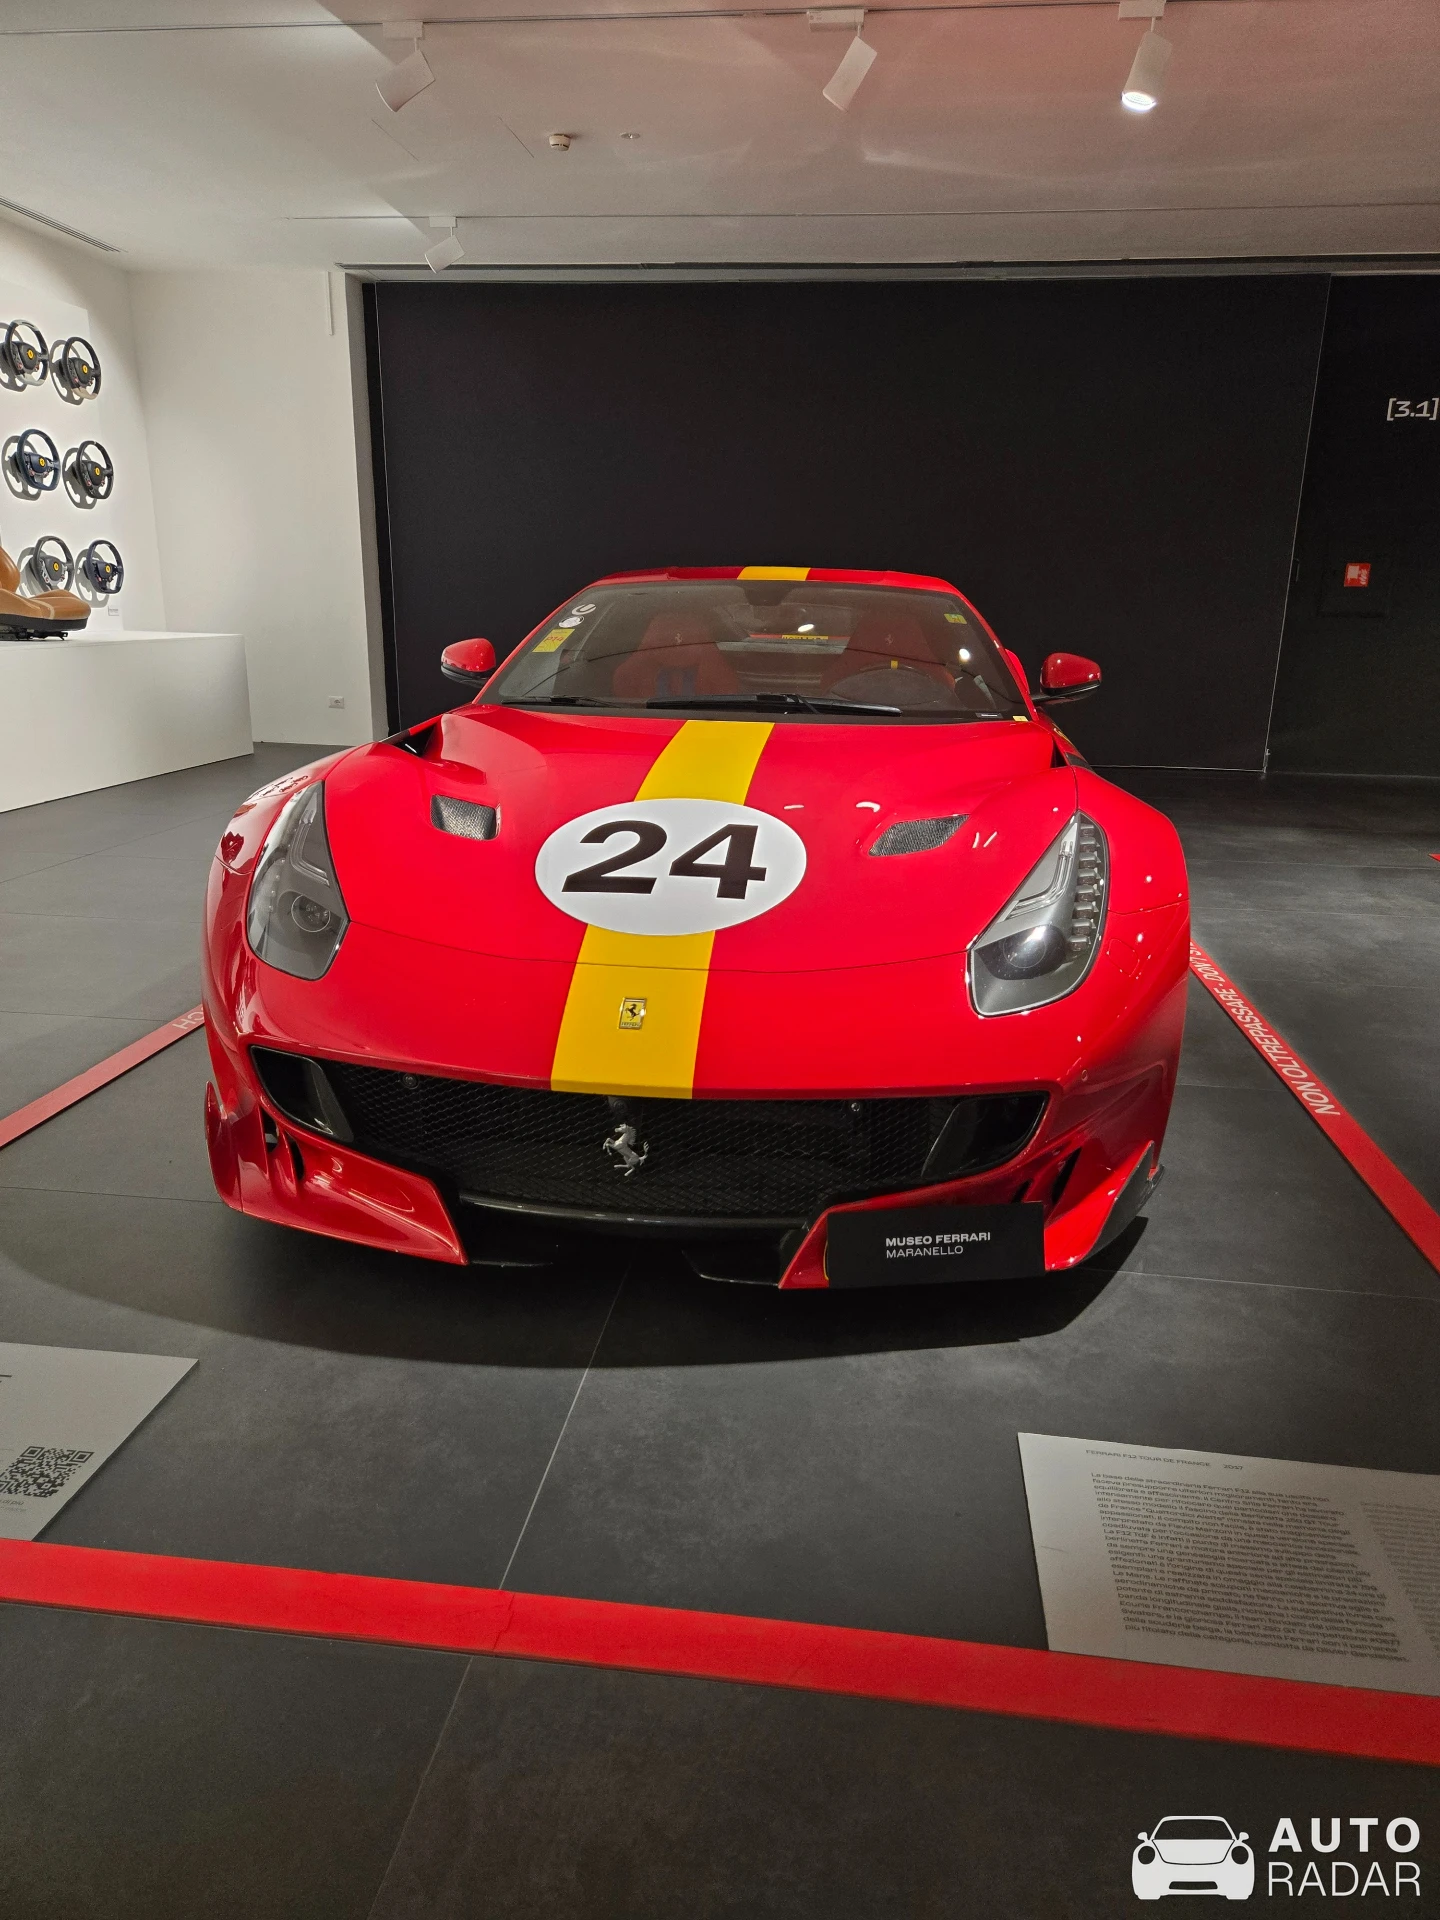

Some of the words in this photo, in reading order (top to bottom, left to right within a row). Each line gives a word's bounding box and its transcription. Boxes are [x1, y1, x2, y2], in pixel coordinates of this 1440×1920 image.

[1387, 397, 1439, 421] [3.1]
[561, 820, 767, 900] 24
[1213, 987, 1308, 1079] OLTREPASSARE
[1292, 1080, 1340, 1116] NON
[885, 1235, 932, 1247] MUSEO
[935, 1231, 991, 1244] FERRARI
[886, 1245, 963, 1259] MARANELLO
[1086, 1449, 1121, 1458] FERRARI
[1176, 1459, 1210, 1467] FRANCE
